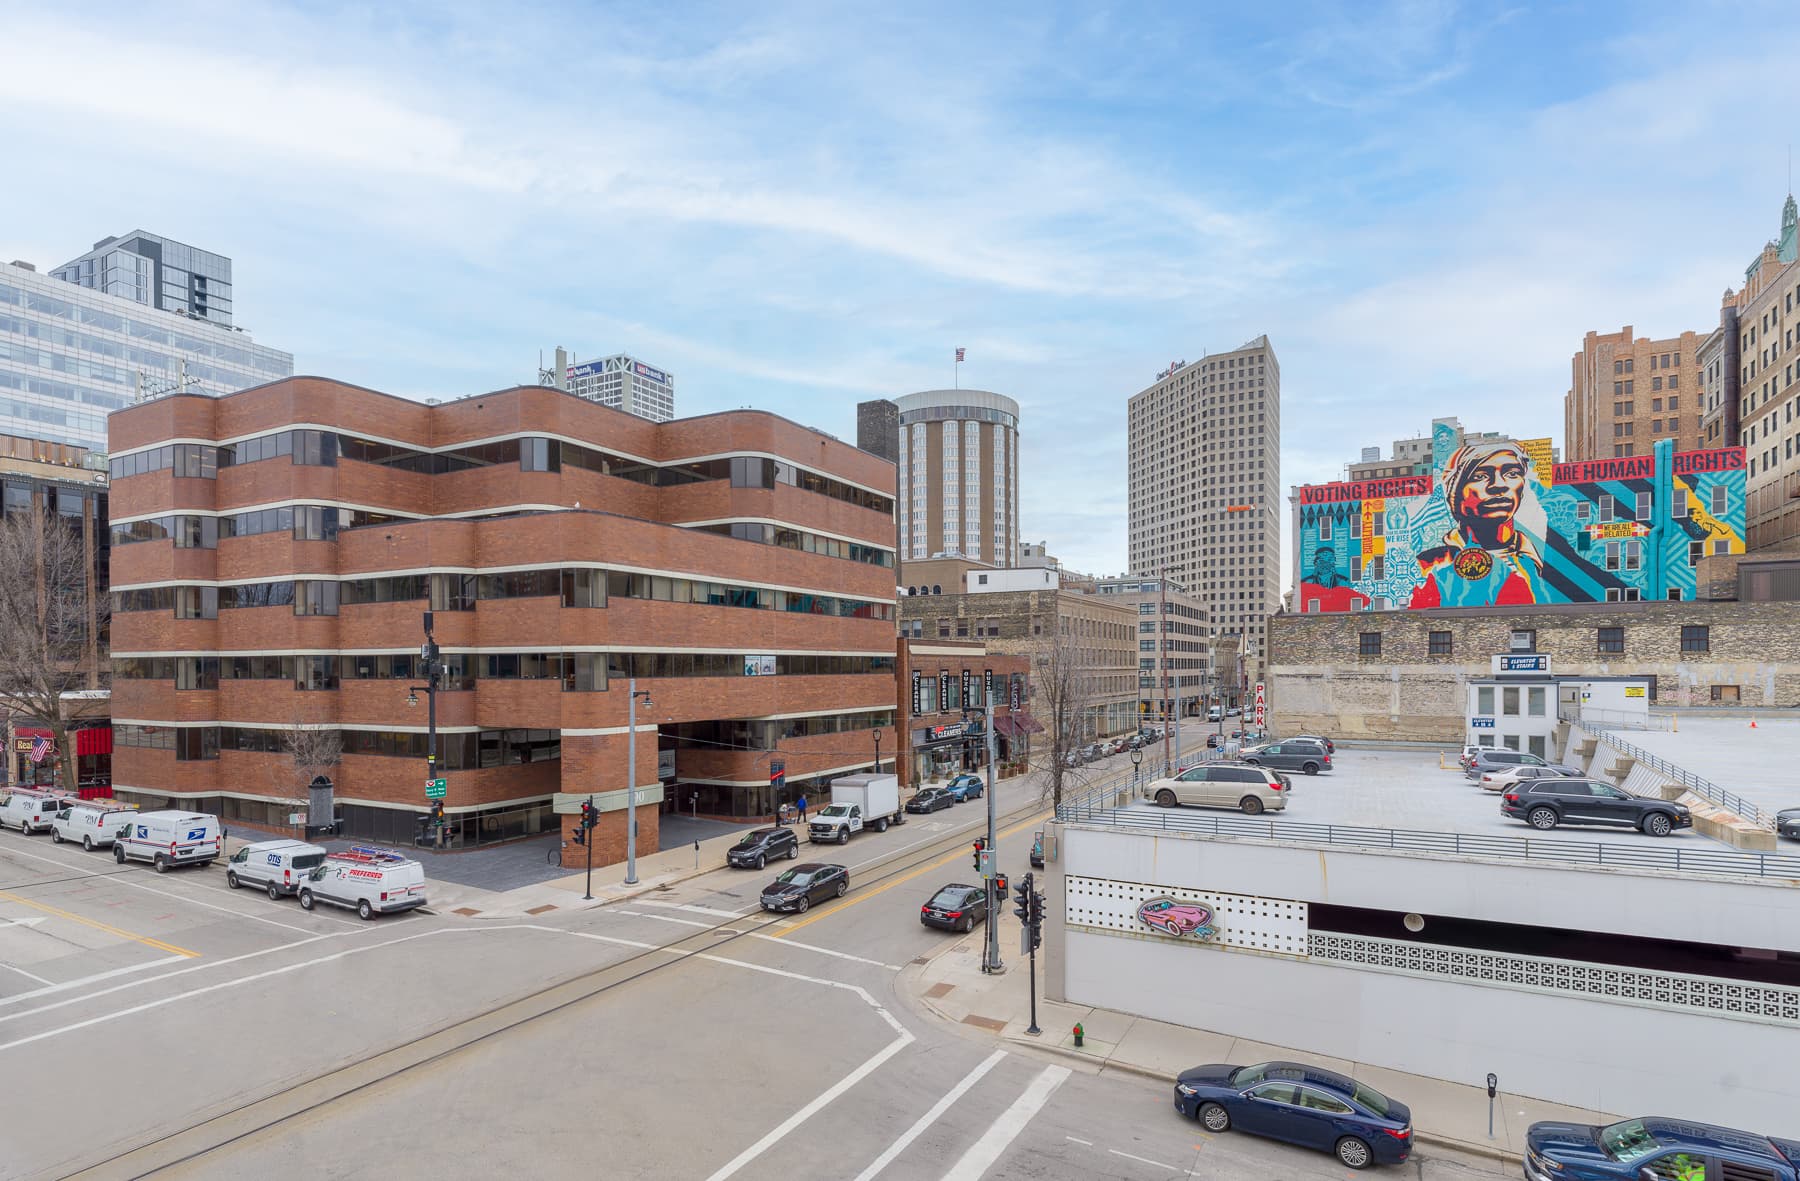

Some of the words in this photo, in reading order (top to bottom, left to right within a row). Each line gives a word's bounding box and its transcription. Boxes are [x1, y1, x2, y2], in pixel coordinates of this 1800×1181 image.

[1674, 450, 1742, 473] RIGHTS
[1555, 466, 1579, 481] ARE
[1583, 459, 1650, 481] HUMAN
[1305, 485, 1362, 503] VOTING
[1367, 479, 1427, 497] RIGHTS
[1256, 685, 1264, 725] PARK
[938, 728, 962, 738] CLEANERS
[17, 740, 33, 750] Real
[267, 853, 282, 864] OTIS
[348, 869, 383, 879] PREFERRED
